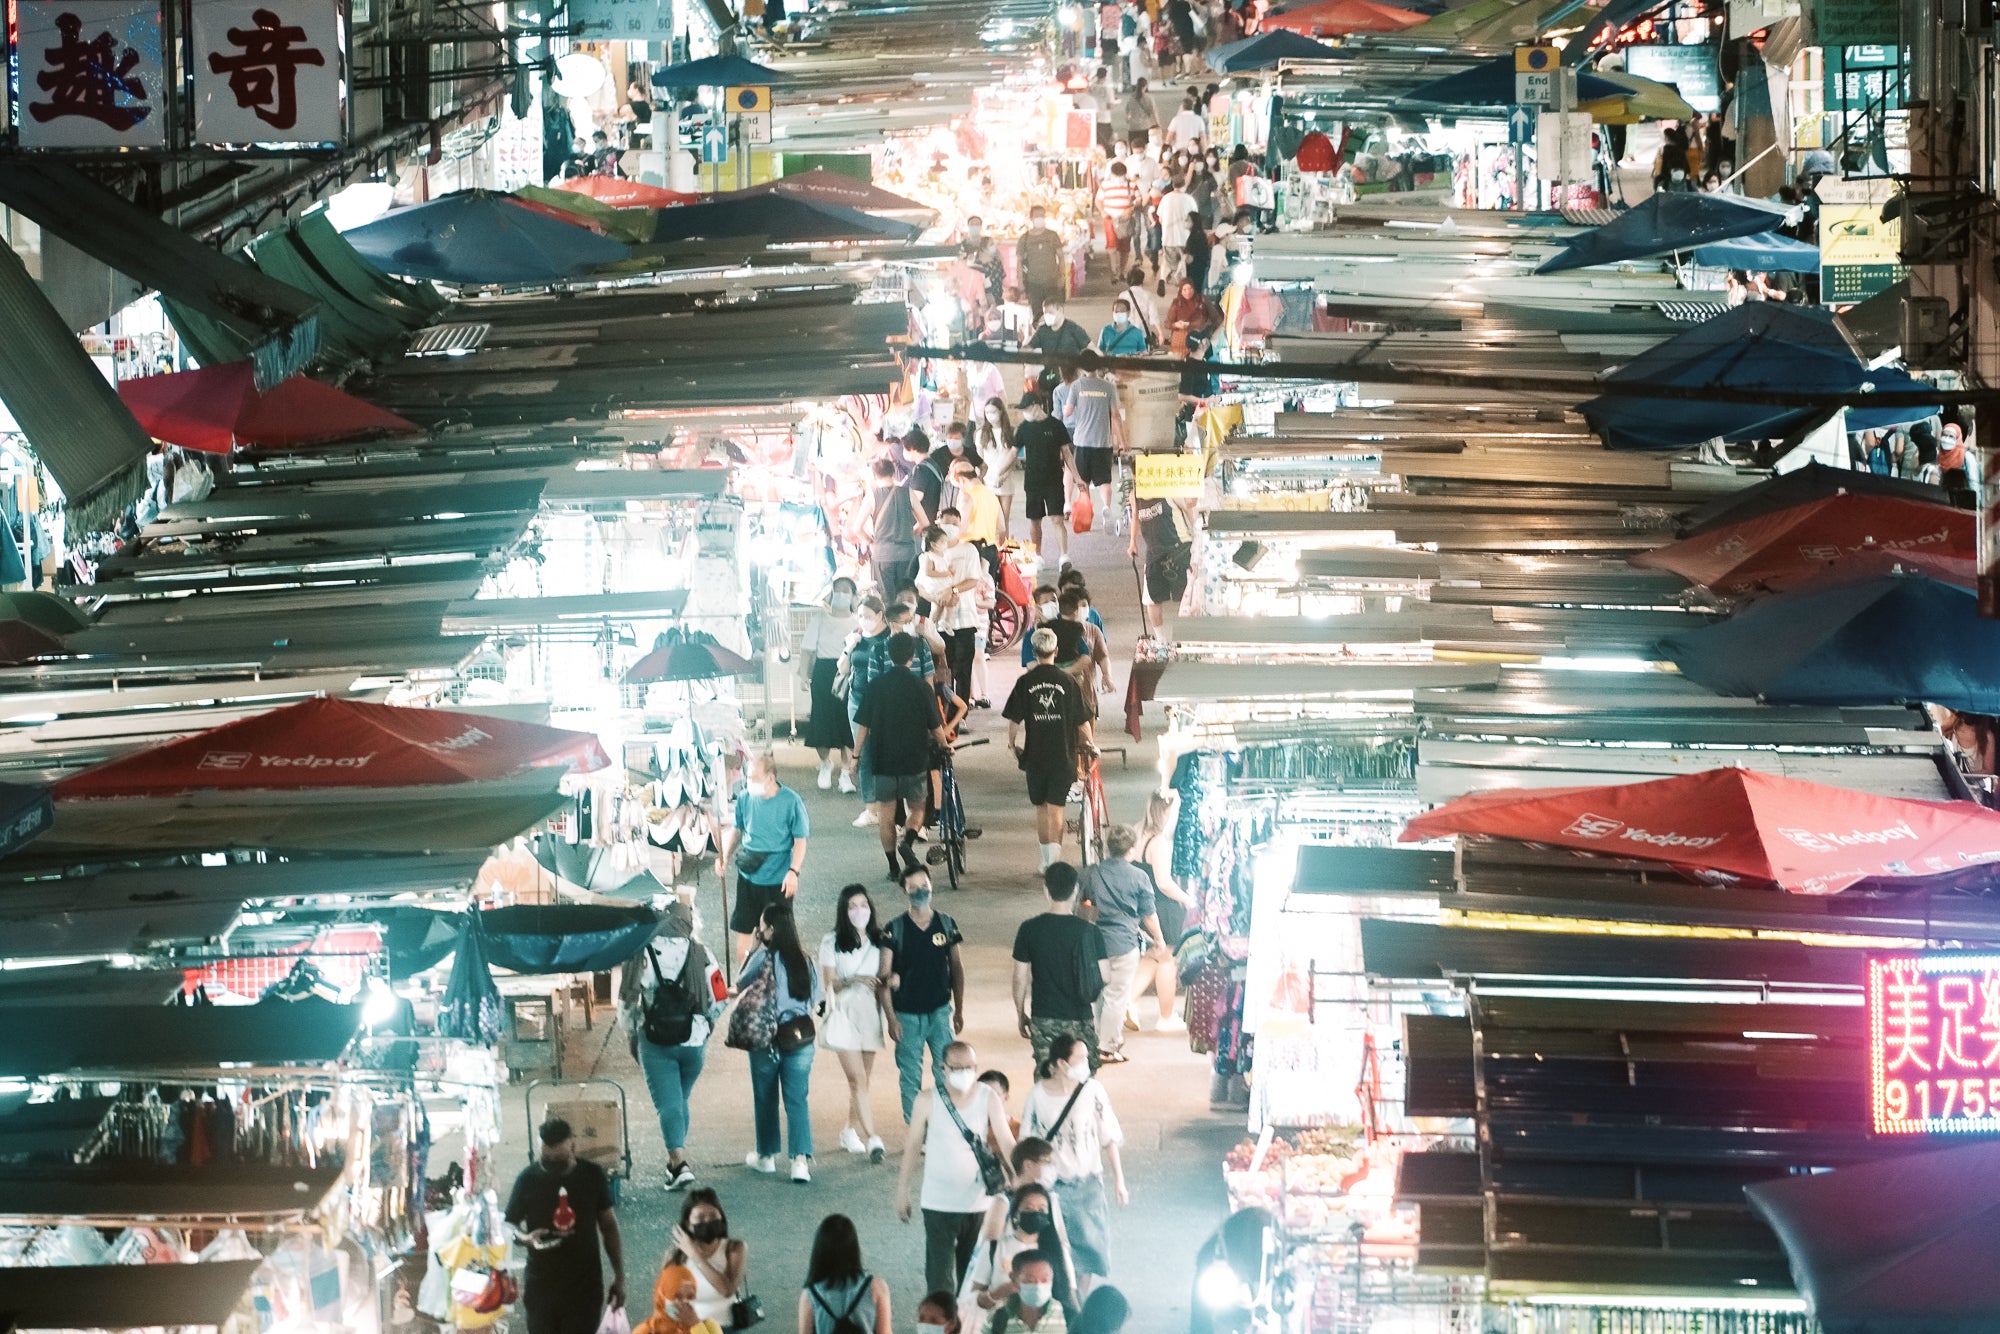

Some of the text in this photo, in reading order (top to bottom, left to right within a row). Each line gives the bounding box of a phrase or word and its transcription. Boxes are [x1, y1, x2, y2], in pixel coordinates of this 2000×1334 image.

[1528, 76, 1548, 86] End
[1847, 527, 1949, 553] Ydpay
[259, 751, 378, 768] Yedpay
[1620, 827, 1728, 849] Yedpay
[1819, 819, 1919, 847] Yedpay
